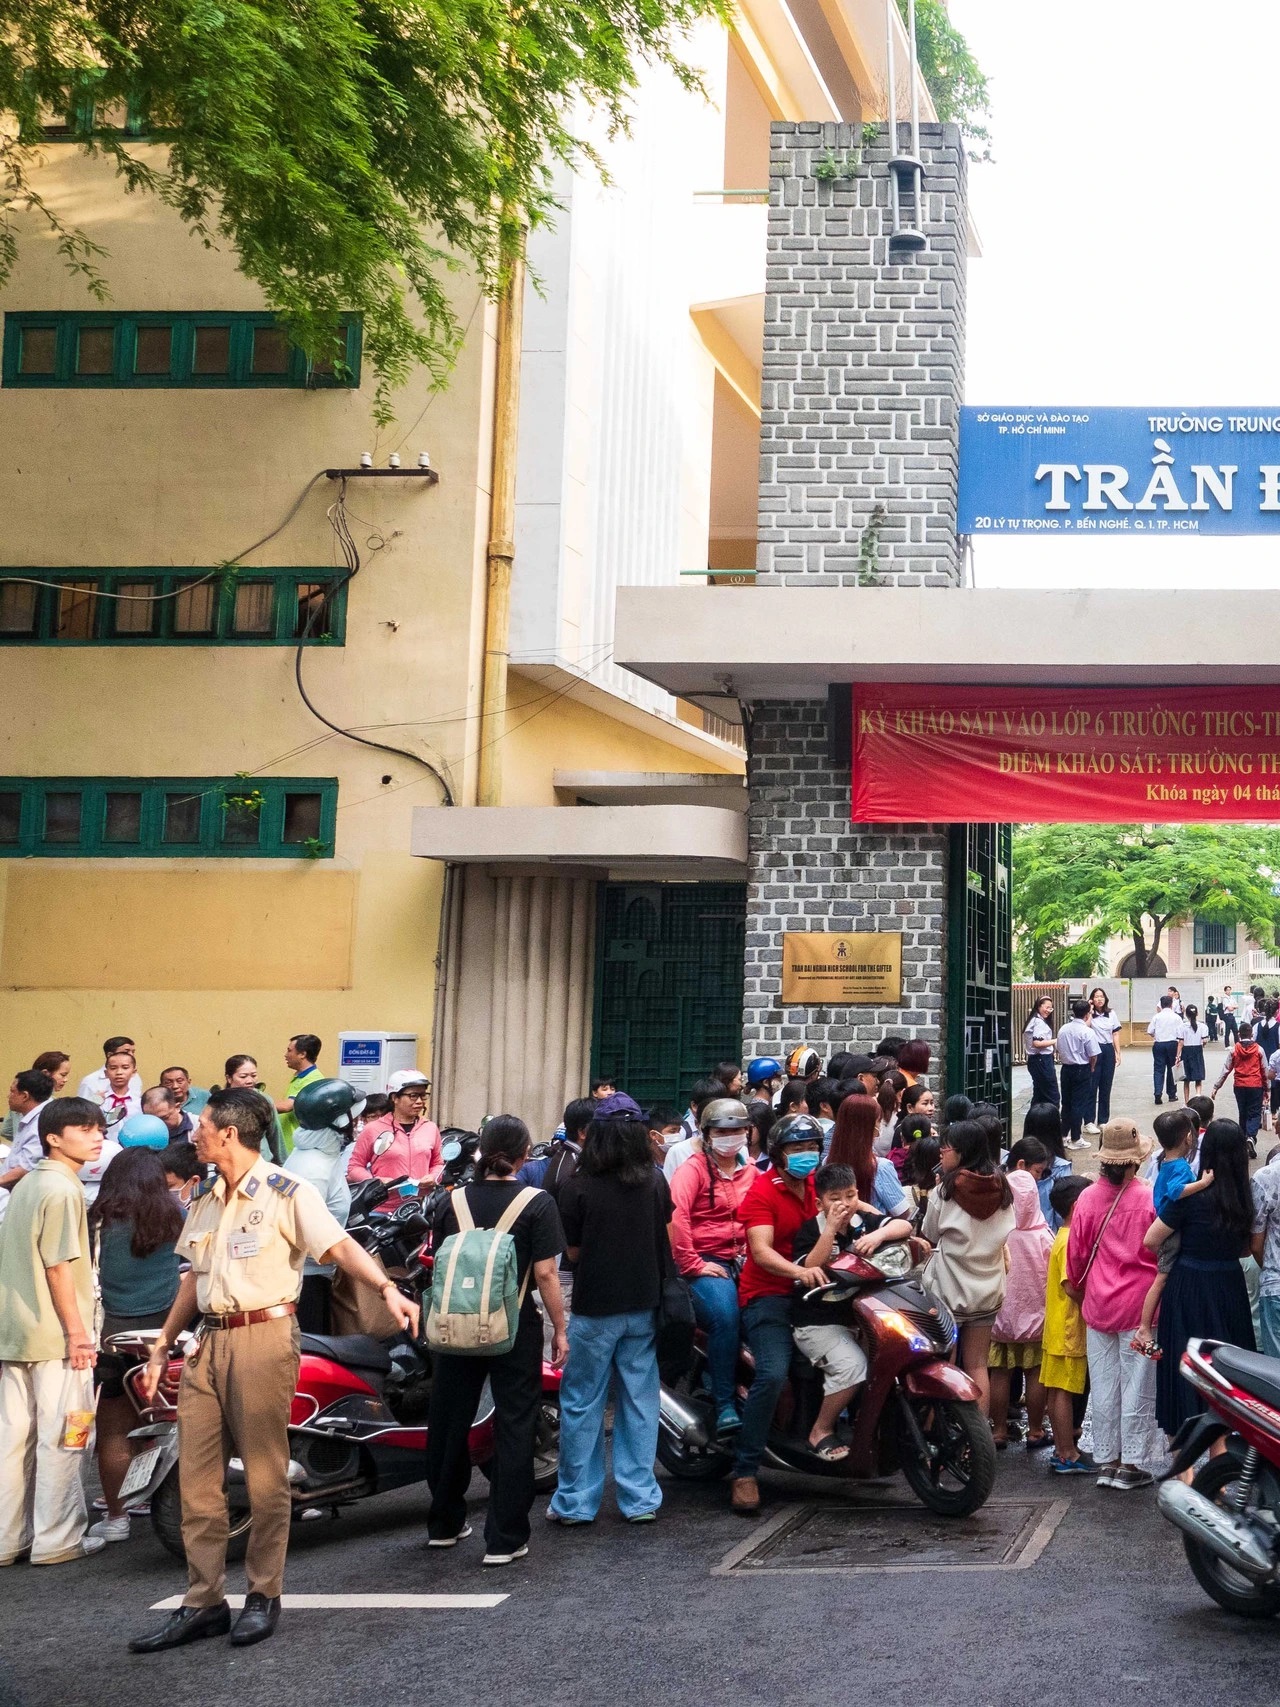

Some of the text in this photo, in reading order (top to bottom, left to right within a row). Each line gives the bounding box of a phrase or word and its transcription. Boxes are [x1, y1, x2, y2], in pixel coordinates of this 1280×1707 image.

[977, 412, 1089, 425] SỞ GIÁO DỤC VÀ ĐÀO TẠO
[999, 424, 1066, 434] TP. HỒ CHÍ MINH
[1148, 411, 1223, 433] TRƯỜNG
[1035, 438, 1238, 511] TRẦN
[975, 517, 991, 528] 20
[994, 517, 1005, 528] LÝ
[1008, 519, 1020, 530] TỰ
[1022, 519, 1062, 530] TRỌNG.
[1065, 520, 1074, 528] P.
[1076, 516, 1096, 529] BẾN
[1099, 517, 1131, 529] NGHÉ.
[1134, 520, 1146, 529] Q.
[1157, 520, 1171, 529] TP.
[1173, 520, 1199, 529] HCM
[860, 703, 888, 734] KỲ
[896, 705, 954, 734] KHẢO
[959, 706, 997, 735] SÁT
[1002, 706, 1046, 736] VÀO
[1051, 705, 1091, 736] LỚP
[1095, 711, 1105, 736] 6
[1109, 703, 1197, 737] TRƯỜNG
[999, 746, 1050, 773] ĐIỂM
[1057, 746, 1115, 774] KHẢO
[1120, 747, 1162, 774] SÁT:
[1168, 747, 1253, 774] TRƯỜNG
[1146, 784, 1187, 800] Khóa
[1192, 784, 1228, 805] ngày
[1233, 784, 1251, 800] 04
